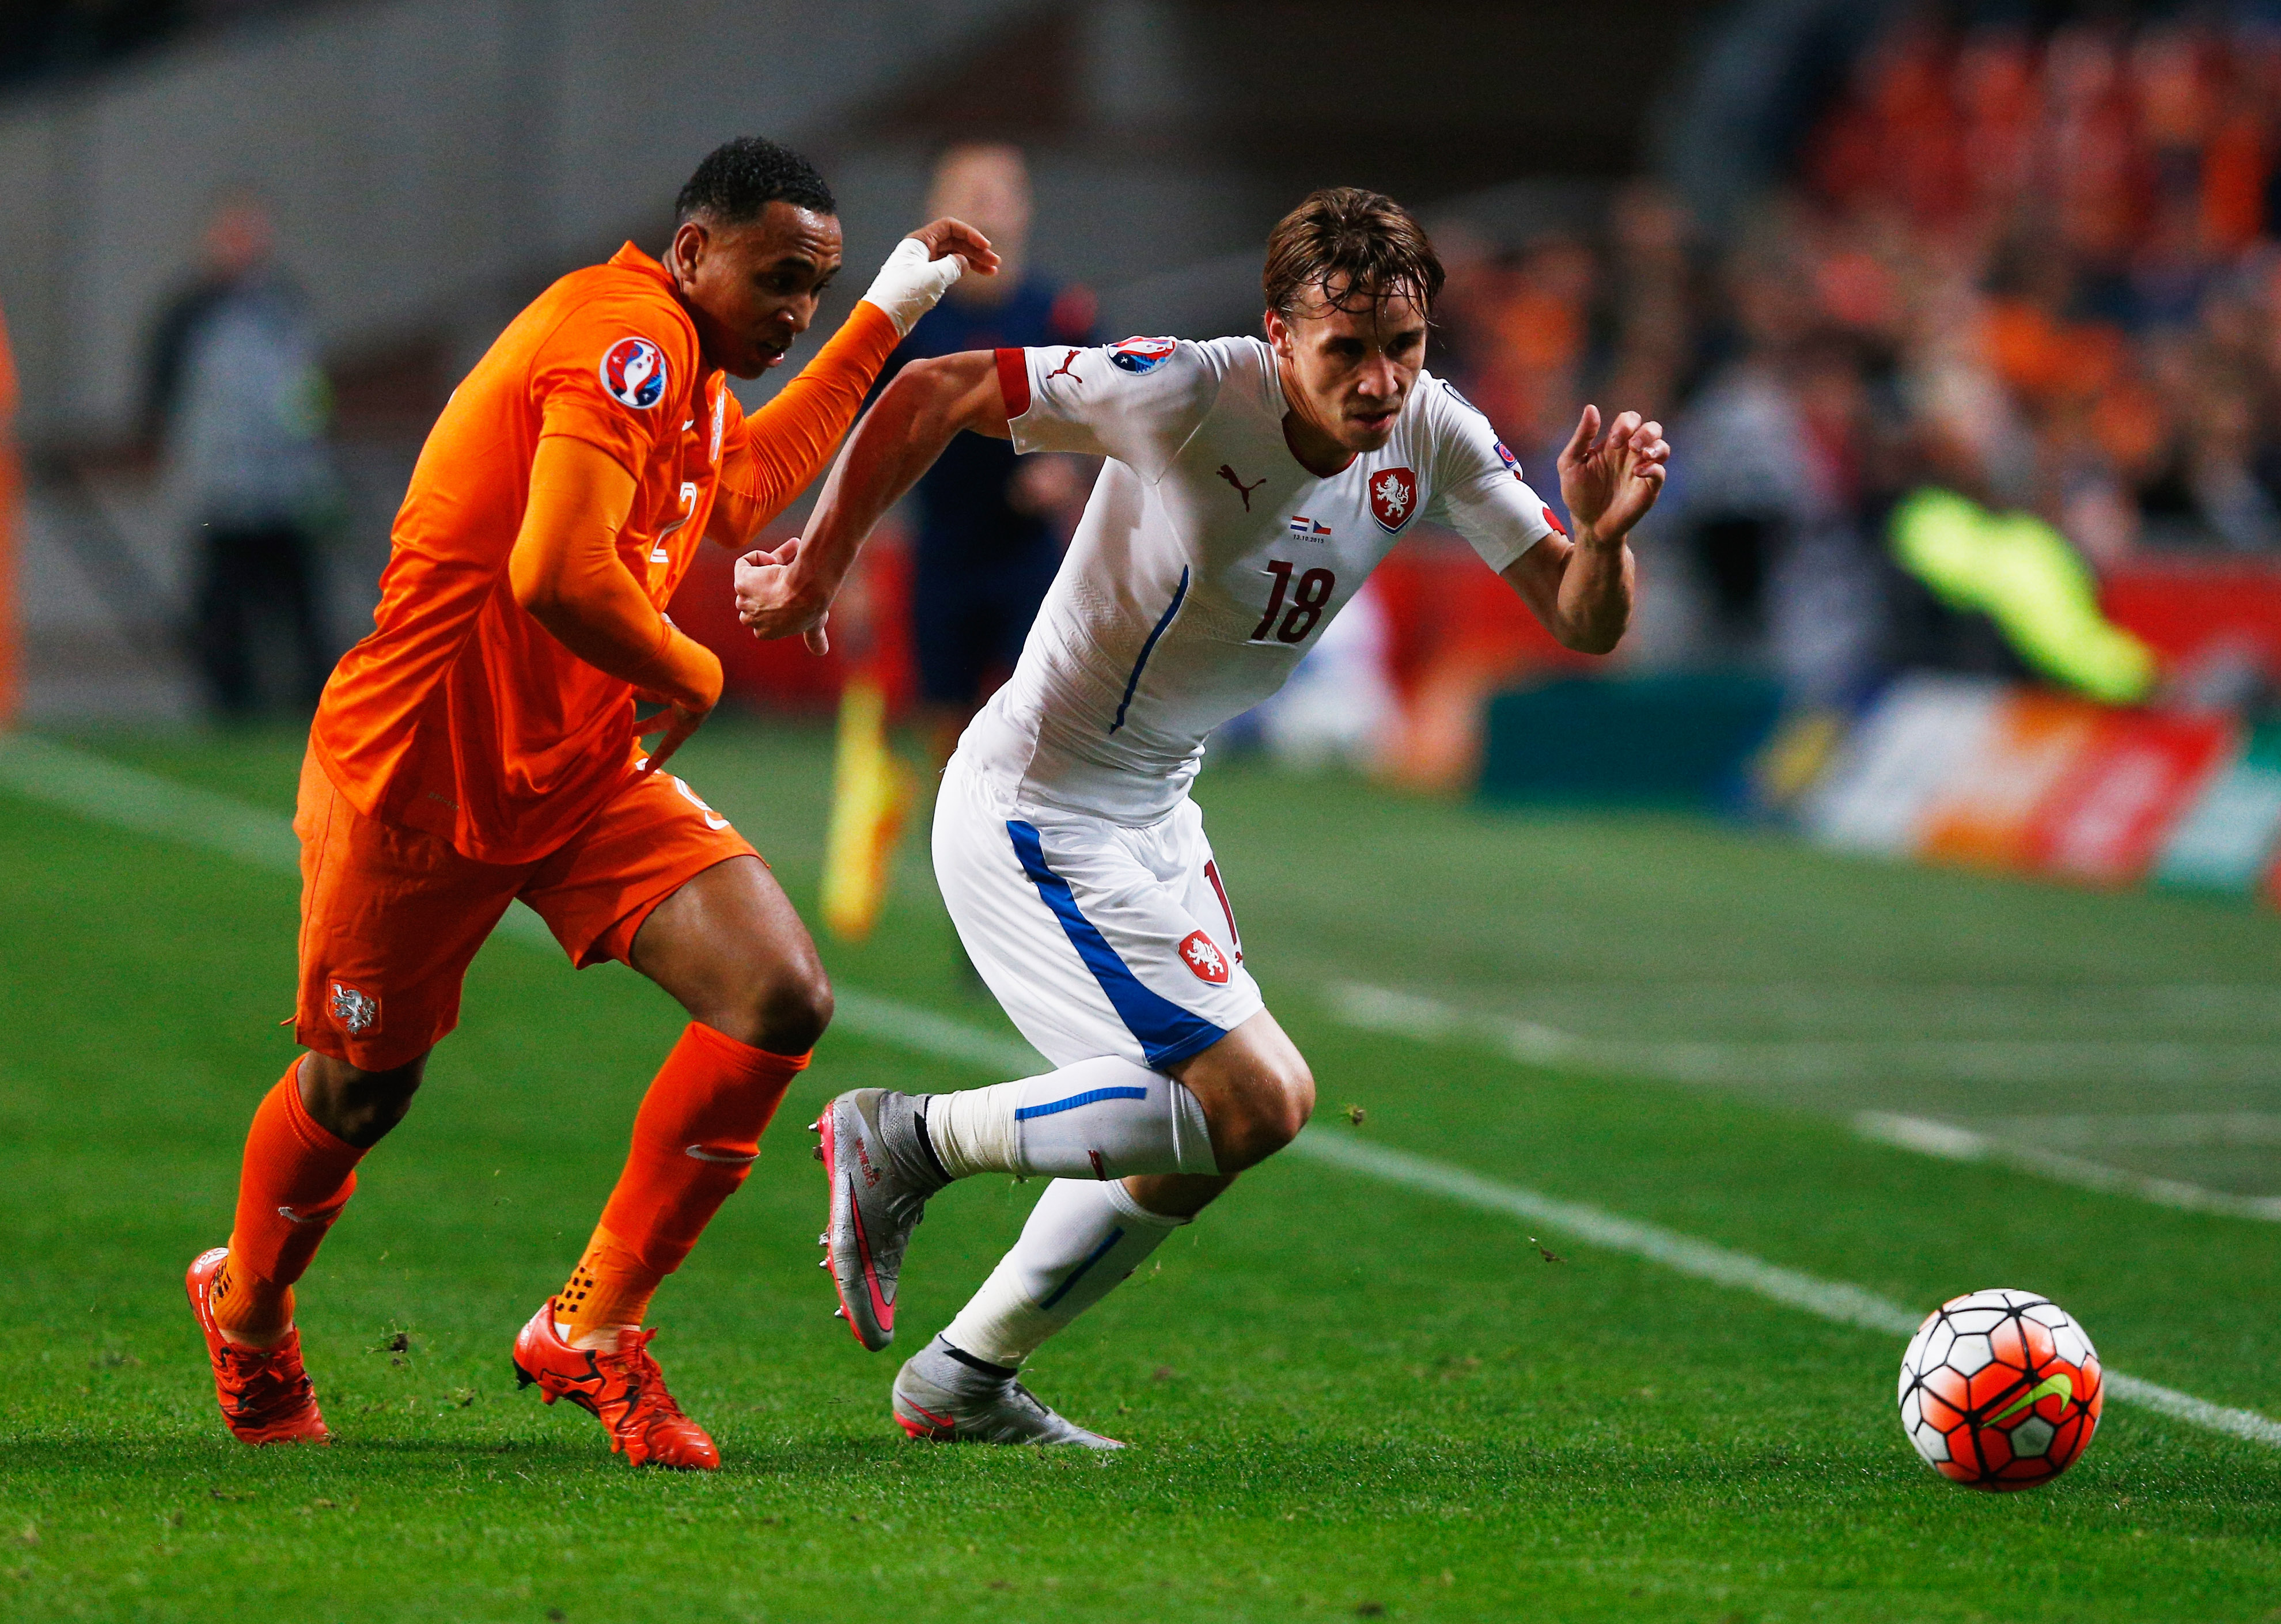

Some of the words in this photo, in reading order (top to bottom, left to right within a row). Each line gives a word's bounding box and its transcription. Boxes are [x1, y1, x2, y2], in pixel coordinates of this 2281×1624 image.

[650, 481, 698, 563] 2
[1293, 534, 1324, 544] 13.10.2015
[1251, 560, 1335, 643] 18
